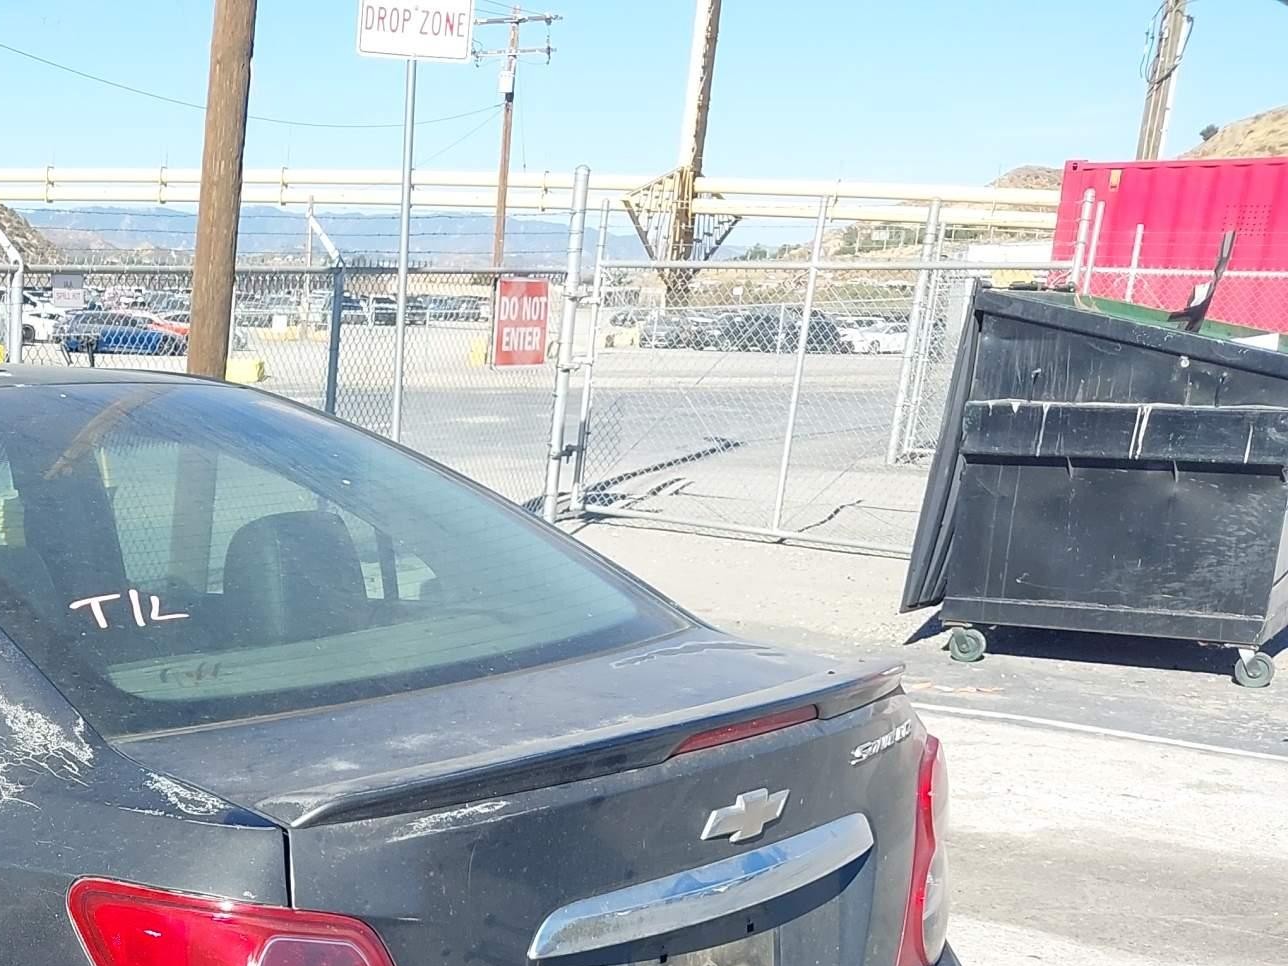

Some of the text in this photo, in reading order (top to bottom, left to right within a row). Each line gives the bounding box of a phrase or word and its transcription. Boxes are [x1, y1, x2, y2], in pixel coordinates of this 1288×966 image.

[364, 5, 467, 38] DROP ZONE
[499, 296, 547, 321] DO NOT
[502, 327, 541, 352] ENTER
